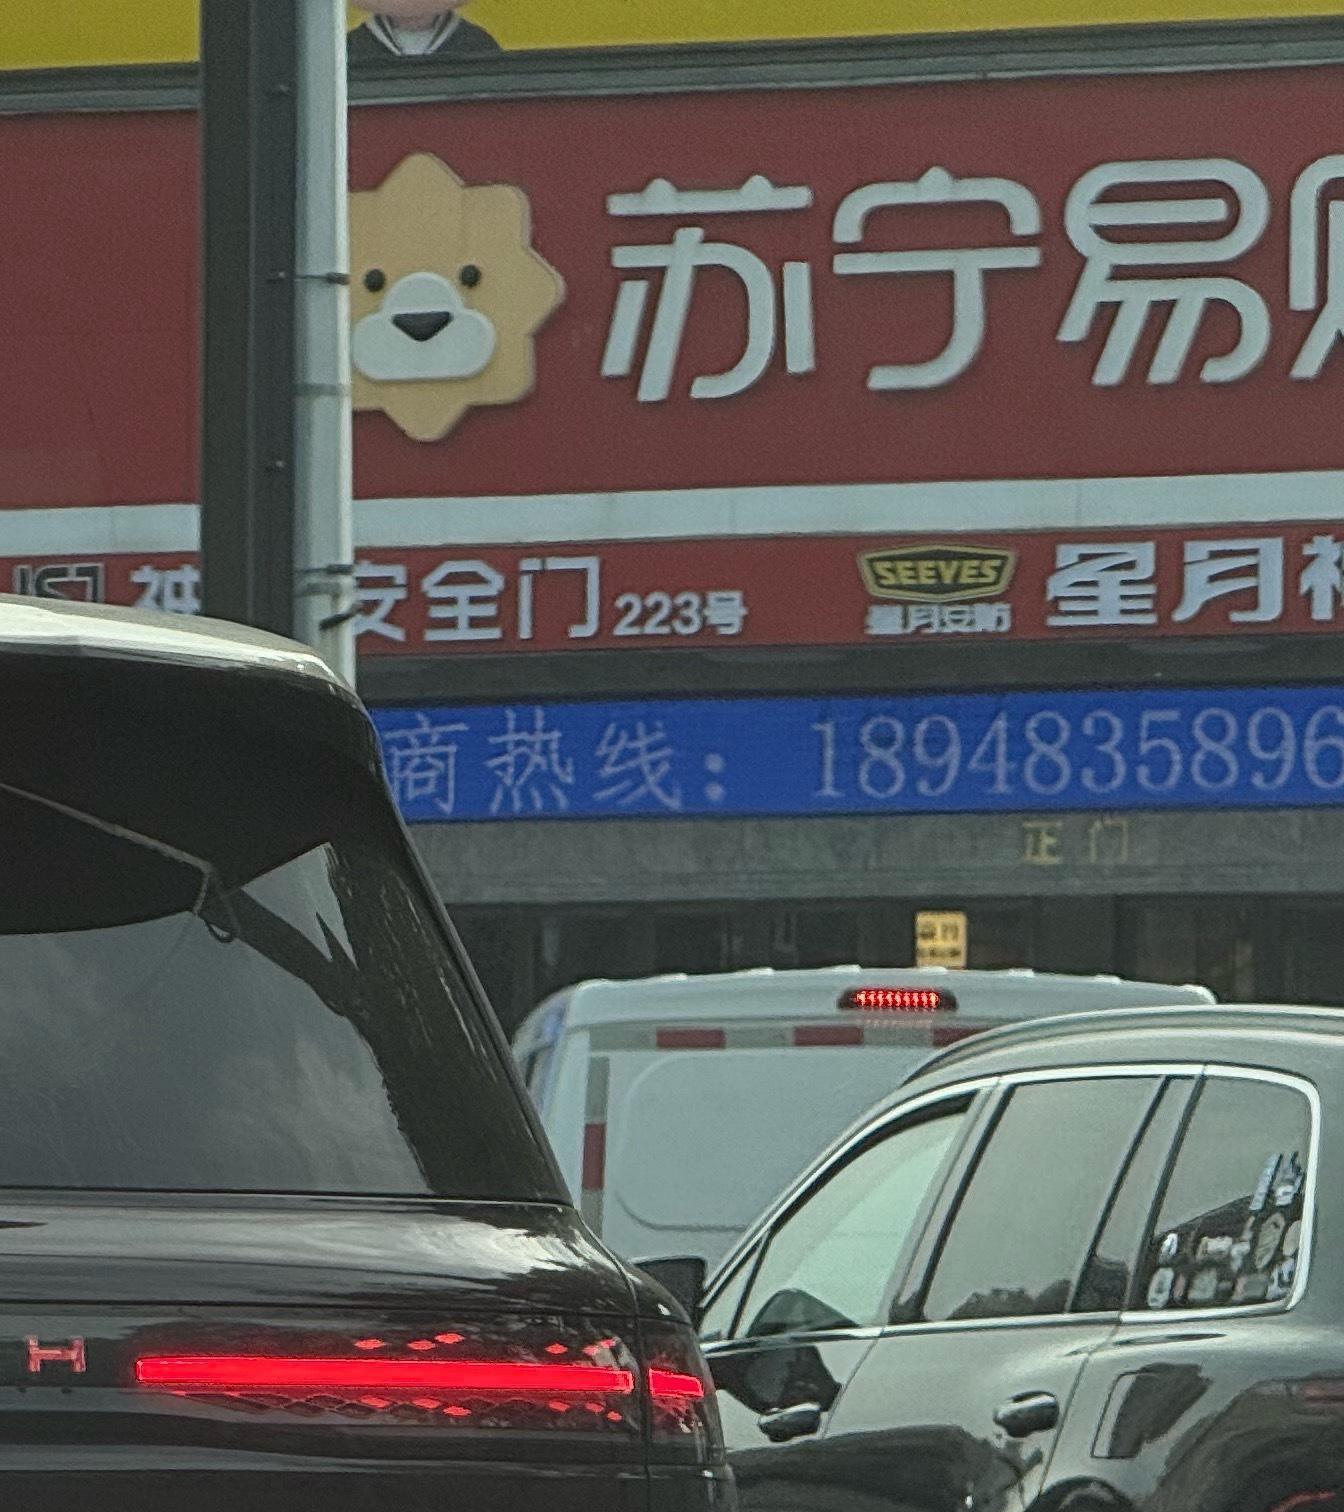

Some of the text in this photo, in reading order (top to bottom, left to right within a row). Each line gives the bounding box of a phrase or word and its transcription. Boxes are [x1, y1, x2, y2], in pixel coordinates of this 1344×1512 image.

[872, 558, 1004, 585] SEEVES
[613, 590, 748, 636] 223号
[813, 705, 1344, 799] 1894835896
